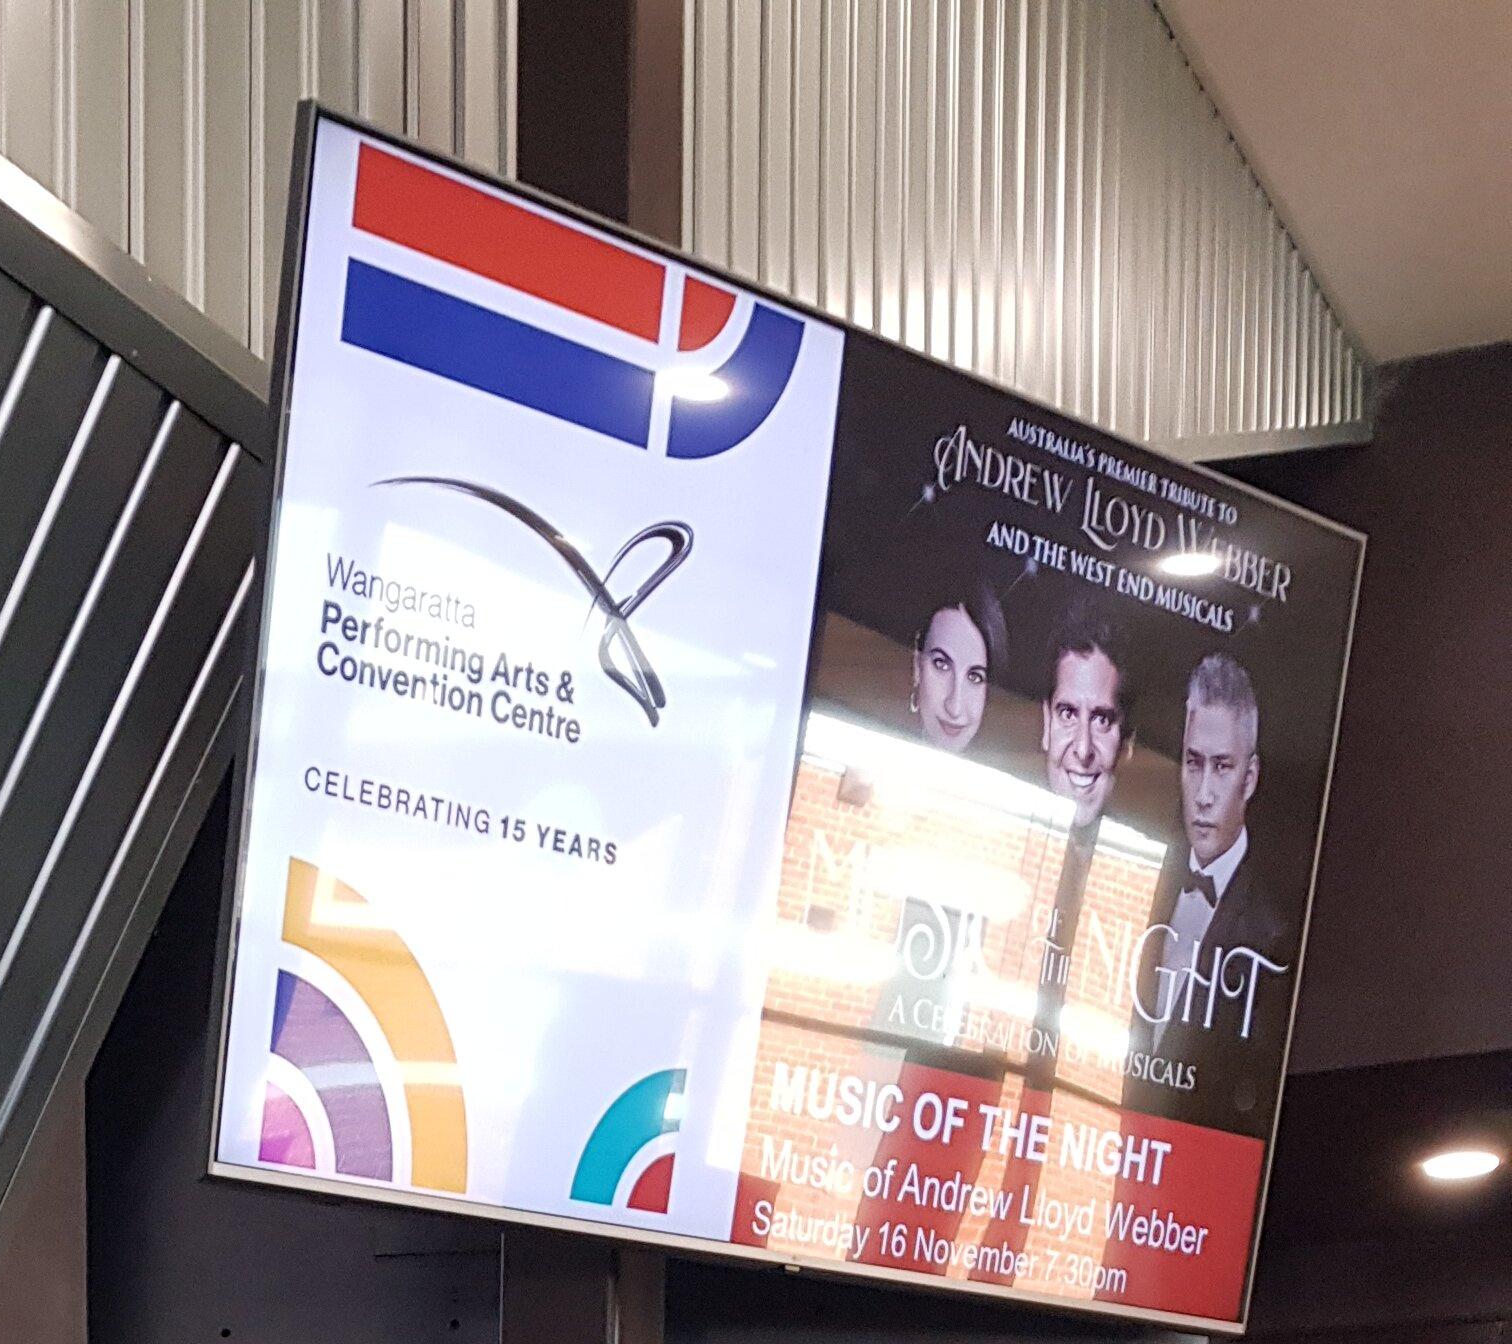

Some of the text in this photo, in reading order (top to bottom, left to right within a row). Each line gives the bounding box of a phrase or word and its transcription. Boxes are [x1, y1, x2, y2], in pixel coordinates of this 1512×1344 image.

[933, 424, 1074, 515] ANDREW
[1080, 476, 1166, 551] LLOYD
[1006, 416, 1238, 526] AUSTRALIA'S PREMIER TRIBUTE TO
[326, 552, 477, 629] Wangaratta
[986, 520, 1234, 634] AND THE WEST END MUSICALS
[316, 641, 581, 745] Convention Centre
[320, 600, 575, 705] Performing Arts &
[304, 766, 618, 867] CELEBRATING 15 YEARS
[770, 1063, 1172, 1187] MUSIC OF THE NIGHT
[752, 1199, 869, 1258] Saturday
[879, 1220, 906, 1257] 16
[914, 1228, 1039, 1280] November
[760, 1135, 1209, 1255] Music of Andrew Lloyd Webber
